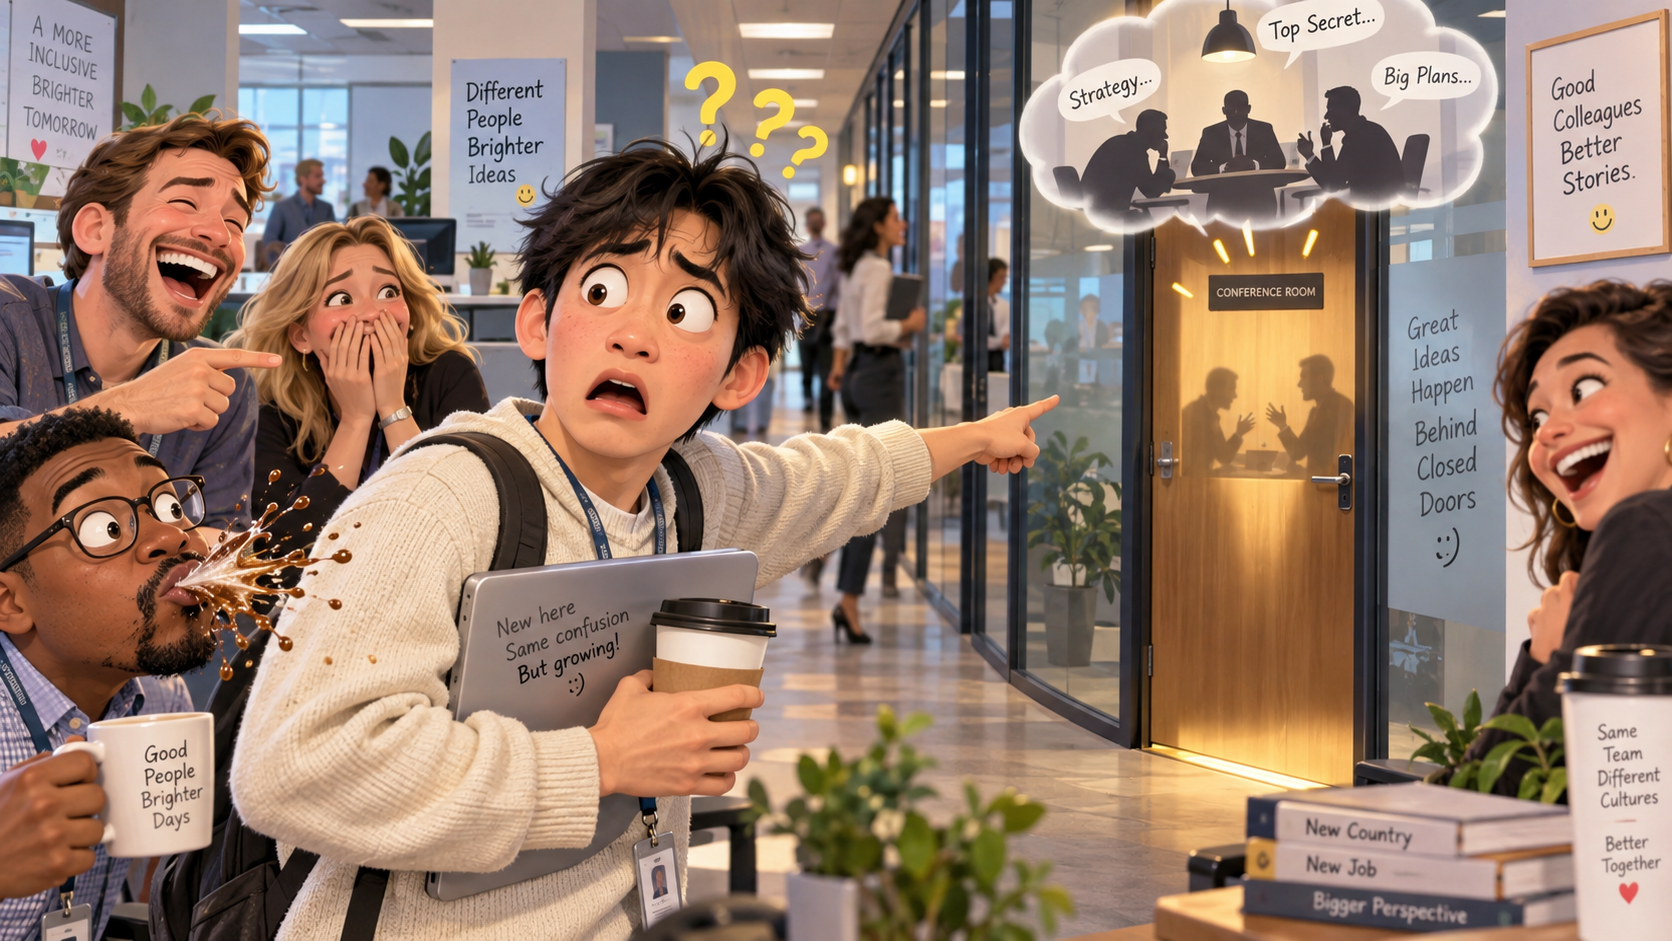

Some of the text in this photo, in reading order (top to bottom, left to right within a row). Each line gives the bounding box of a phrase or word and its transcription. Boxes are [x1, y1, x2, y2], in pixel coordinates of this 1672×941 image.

[33, 15, 93, 53] A MORE
[28, 42, 98, 80] INCLUSIVE
[32, 75, 95, 110] BRIGHTER
[466, 79, 544, 105] Different
[1552, 69, 1595, 100] Good
[23, 106, 98, 141] TOMORROW
[467, 107, 522, 133] People
[1554, 98, 1643, 132] Colleagues
[468, 136, 543, 162] Brighter
[1560, 134, 1623, 165] Better
[469, 164, 515, 183] Ideas
[1562, 164, 1636, 195] Stories.
[1216, 286, 1316, 298] CONFERENCE ROOM
[1408, 309, 1459, 340] Great
[1413, 345, 1459, 371] Ideas
[1412, 376, 1473, 406] Happen
[1415, 409, 1477, 447] Behind
[1417, 445, 1477, 480] Closed
[1420, 491, 1476, 517] Doors
[497, 603, 575, 638] New here
[505, 609, 630, 662] Same confusion
[518, 632, 620, 684] But growing!
[1598, 724, 1637, 740] Same
[144, 739, 188, 763] Good
[1603, 746, 1642, 762] Team
[144, 762, 196, 787] People
[1598, 767, 1660, 788] Different
[141, 786, 203, 811] Brighter
[1601, 791, 1658, 808] Cultures
[152, 811, 191, 831] Days
[1306, 818, 1412, 850] New Country
[1606, 836, 1648, 852] Better
[1307, 856, 1341, 873] New
[1348, 858, 1377, 877] Job
[1602, 855, 1661, 877] Together
[1313, 891, 1468, 925] Bigger Perspective
